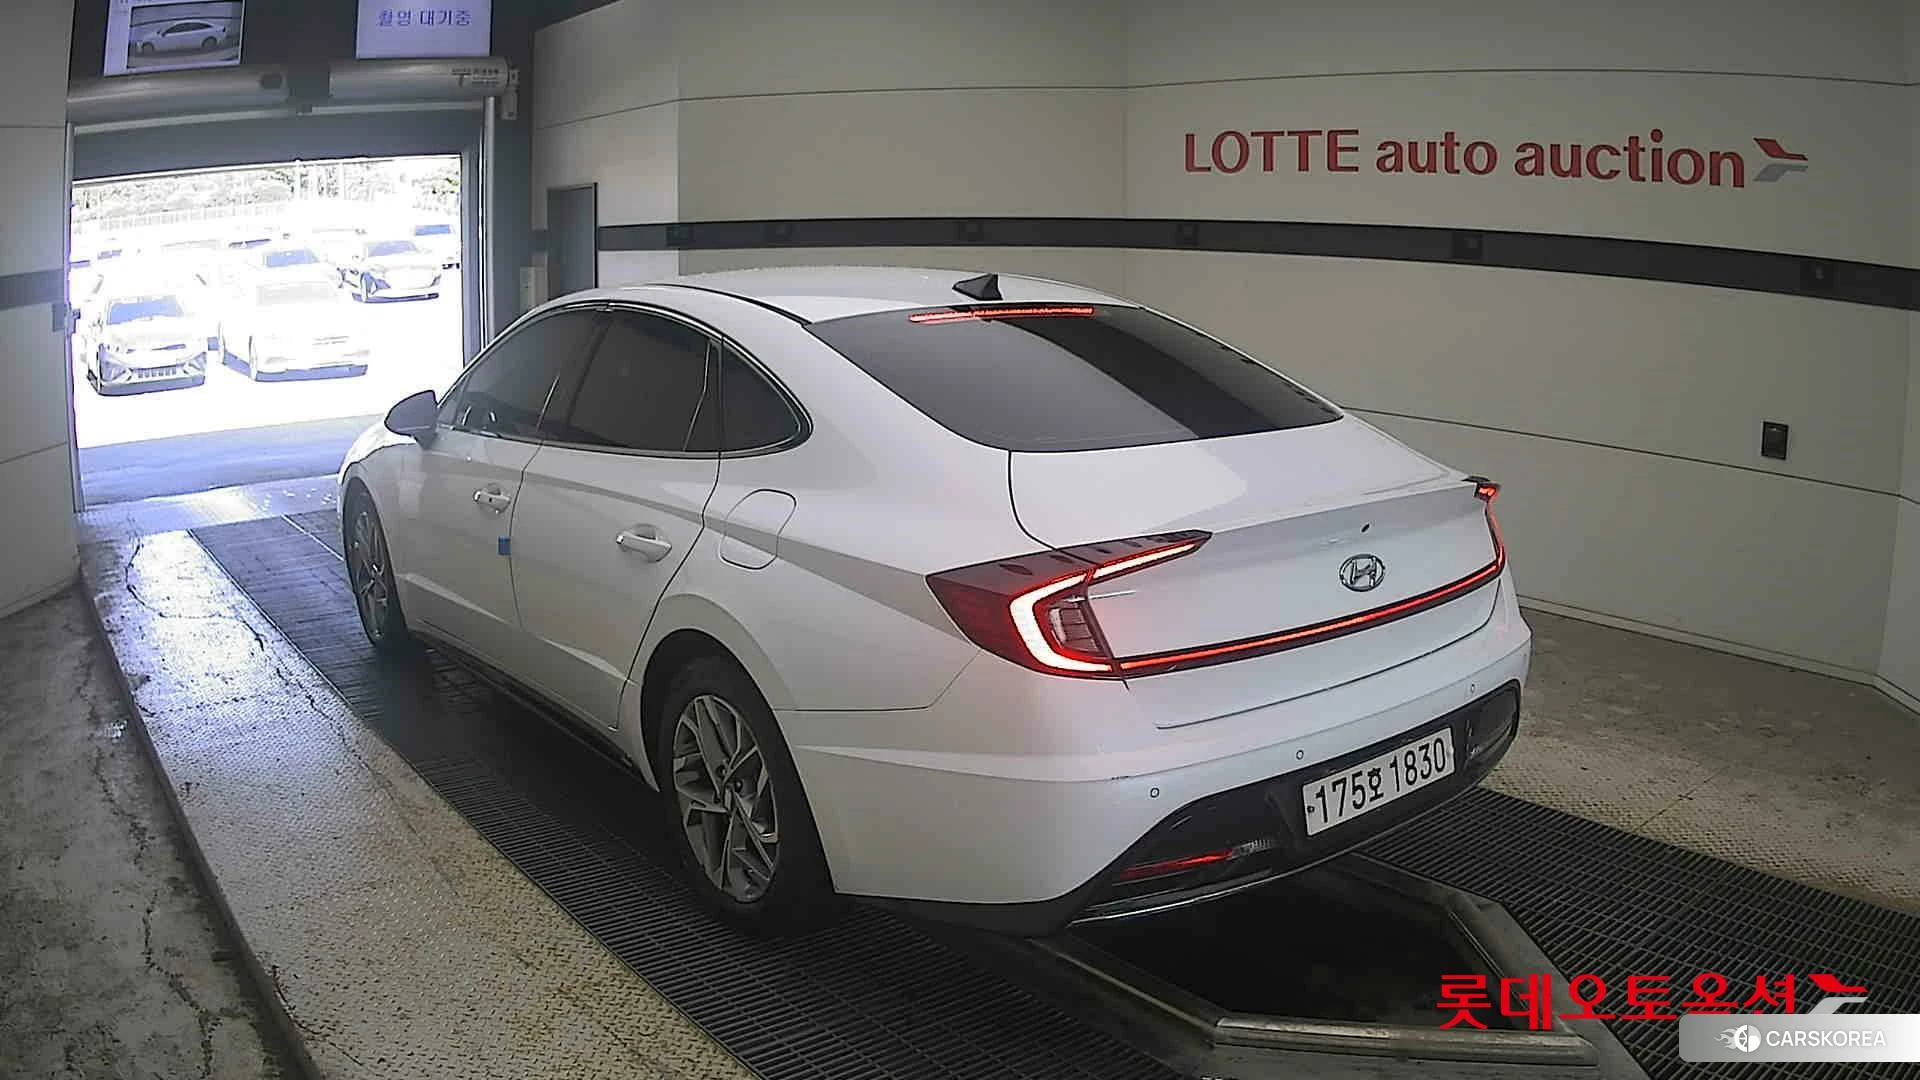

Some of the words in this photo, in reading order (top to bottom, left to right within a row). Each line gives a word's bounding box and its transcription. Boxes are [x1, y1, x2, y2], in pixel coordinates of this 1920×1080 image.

[420, 9, 472, 26] 대기중
[1184, 128, 1360, 174] LOTTE
[1376, 131, 1498, 175] auto
[1514, 128, 1745, 188] auction
[1315, 767, 1384, 823] 175호
[1389, 737, 1446, 792] 1830
